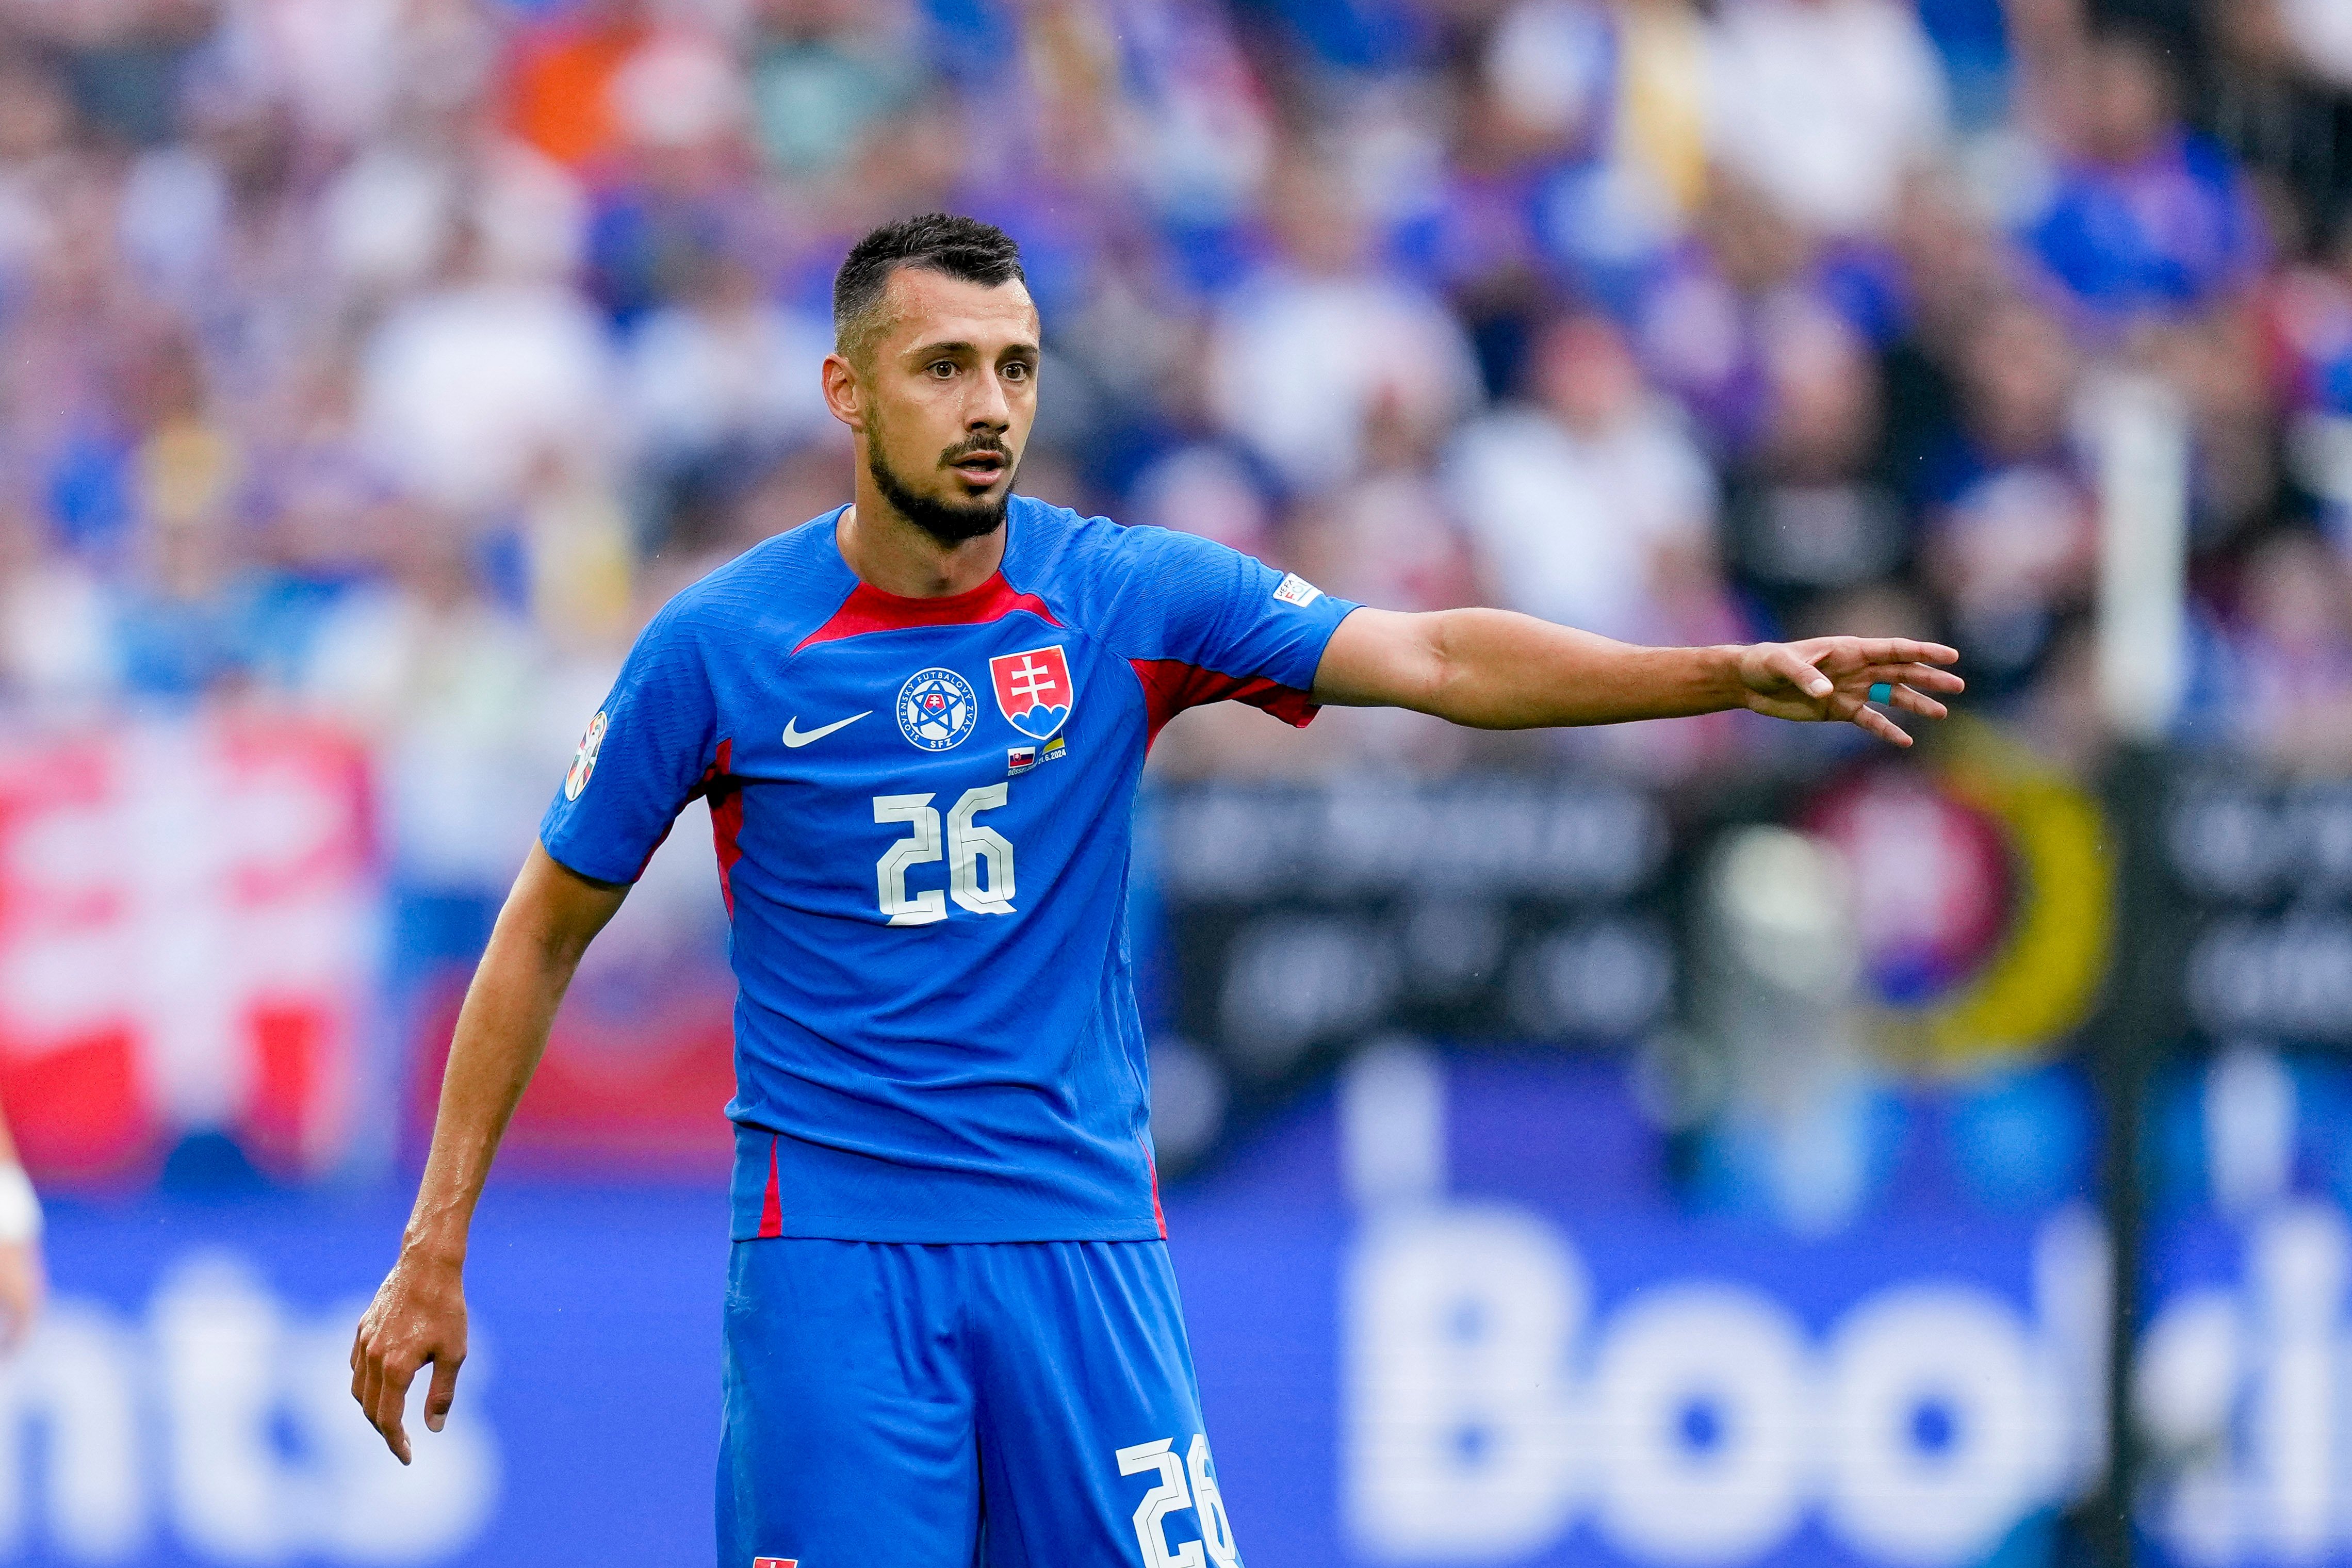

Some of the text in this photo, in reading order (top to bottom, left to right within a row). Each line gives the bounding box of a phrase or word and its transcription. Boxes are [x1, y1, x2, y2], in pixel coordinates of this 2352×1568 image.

[1277, 579, 1294, 597] UEFA
[900, 683, 920, 741] SLOVENSKÝ
[917, 672, 973, 700] FUTBALOVÝ
[930, 738, 953, 748] SFZ
[873, 781, 1018, 926] 26
[1115, 1433, 1240, 1568] 26
